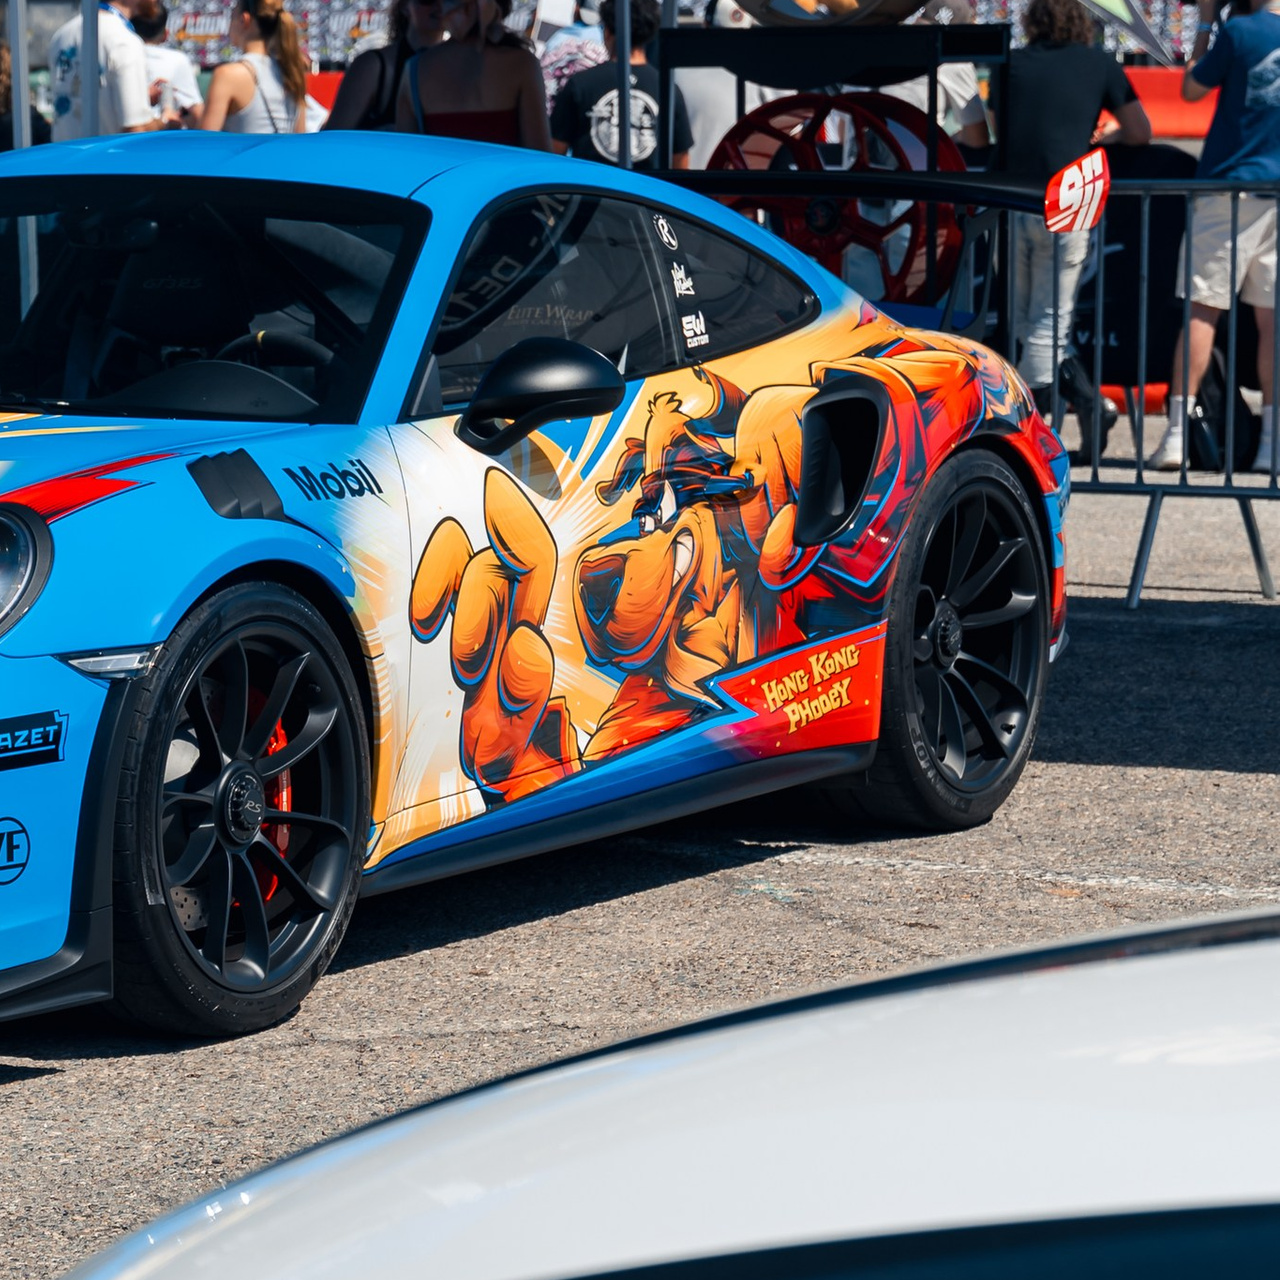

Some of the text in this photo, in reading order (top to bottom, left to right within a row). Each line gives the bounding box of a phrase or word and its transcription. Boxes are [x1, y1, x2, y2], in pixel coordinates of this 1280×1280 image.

[681, 310, 706, 337] EW
[282, 458, 384, 502] Mobil
[244, 800, 262, 813] RS
